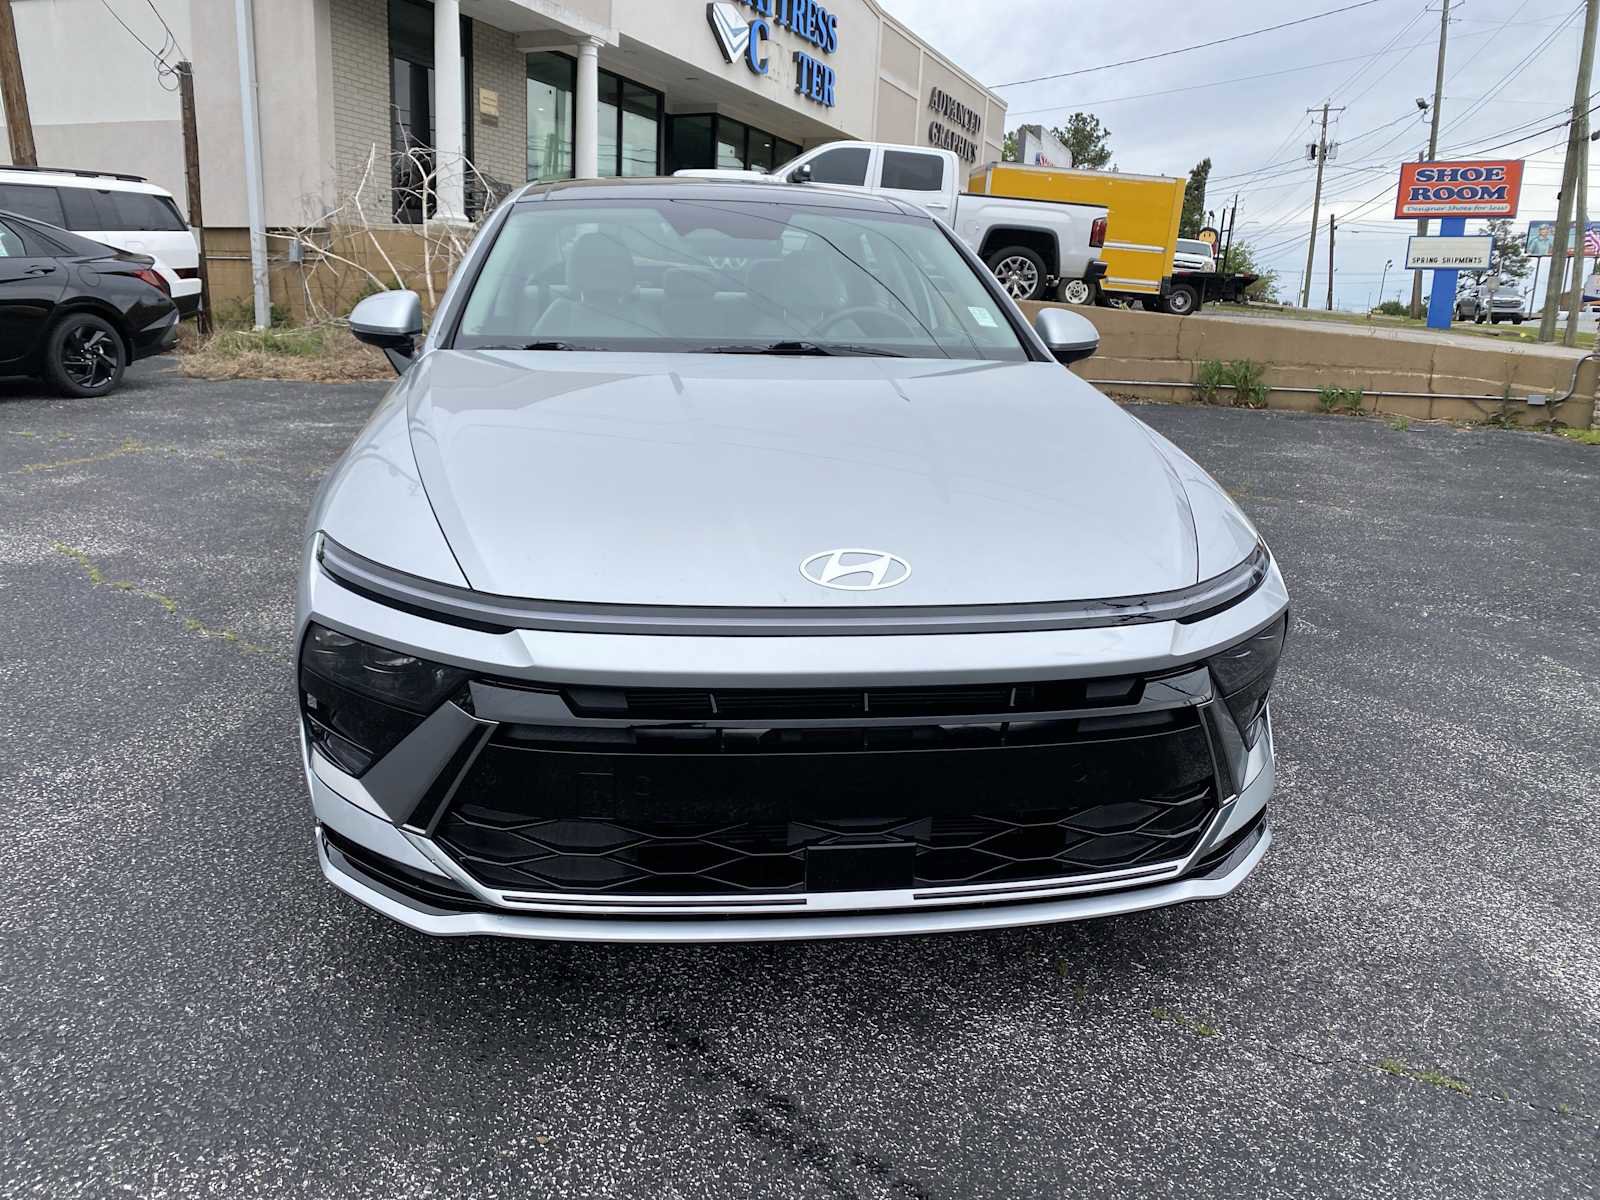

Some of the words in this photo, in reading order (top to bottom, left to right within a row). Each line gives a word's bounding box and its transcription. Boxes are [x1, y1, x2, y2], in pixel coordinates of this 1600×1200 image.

[929, 86, 981, 134] ADVANCED
[928, 121, 978, 164] GRAPHICS
[1415, 166, 1505, 183] SHOE
[1408, 184, 1509, 201] ROOM
[1412, 256, 1438, 264] SPRING
[1442, 256, 1483, 264] SHIPMENTS
